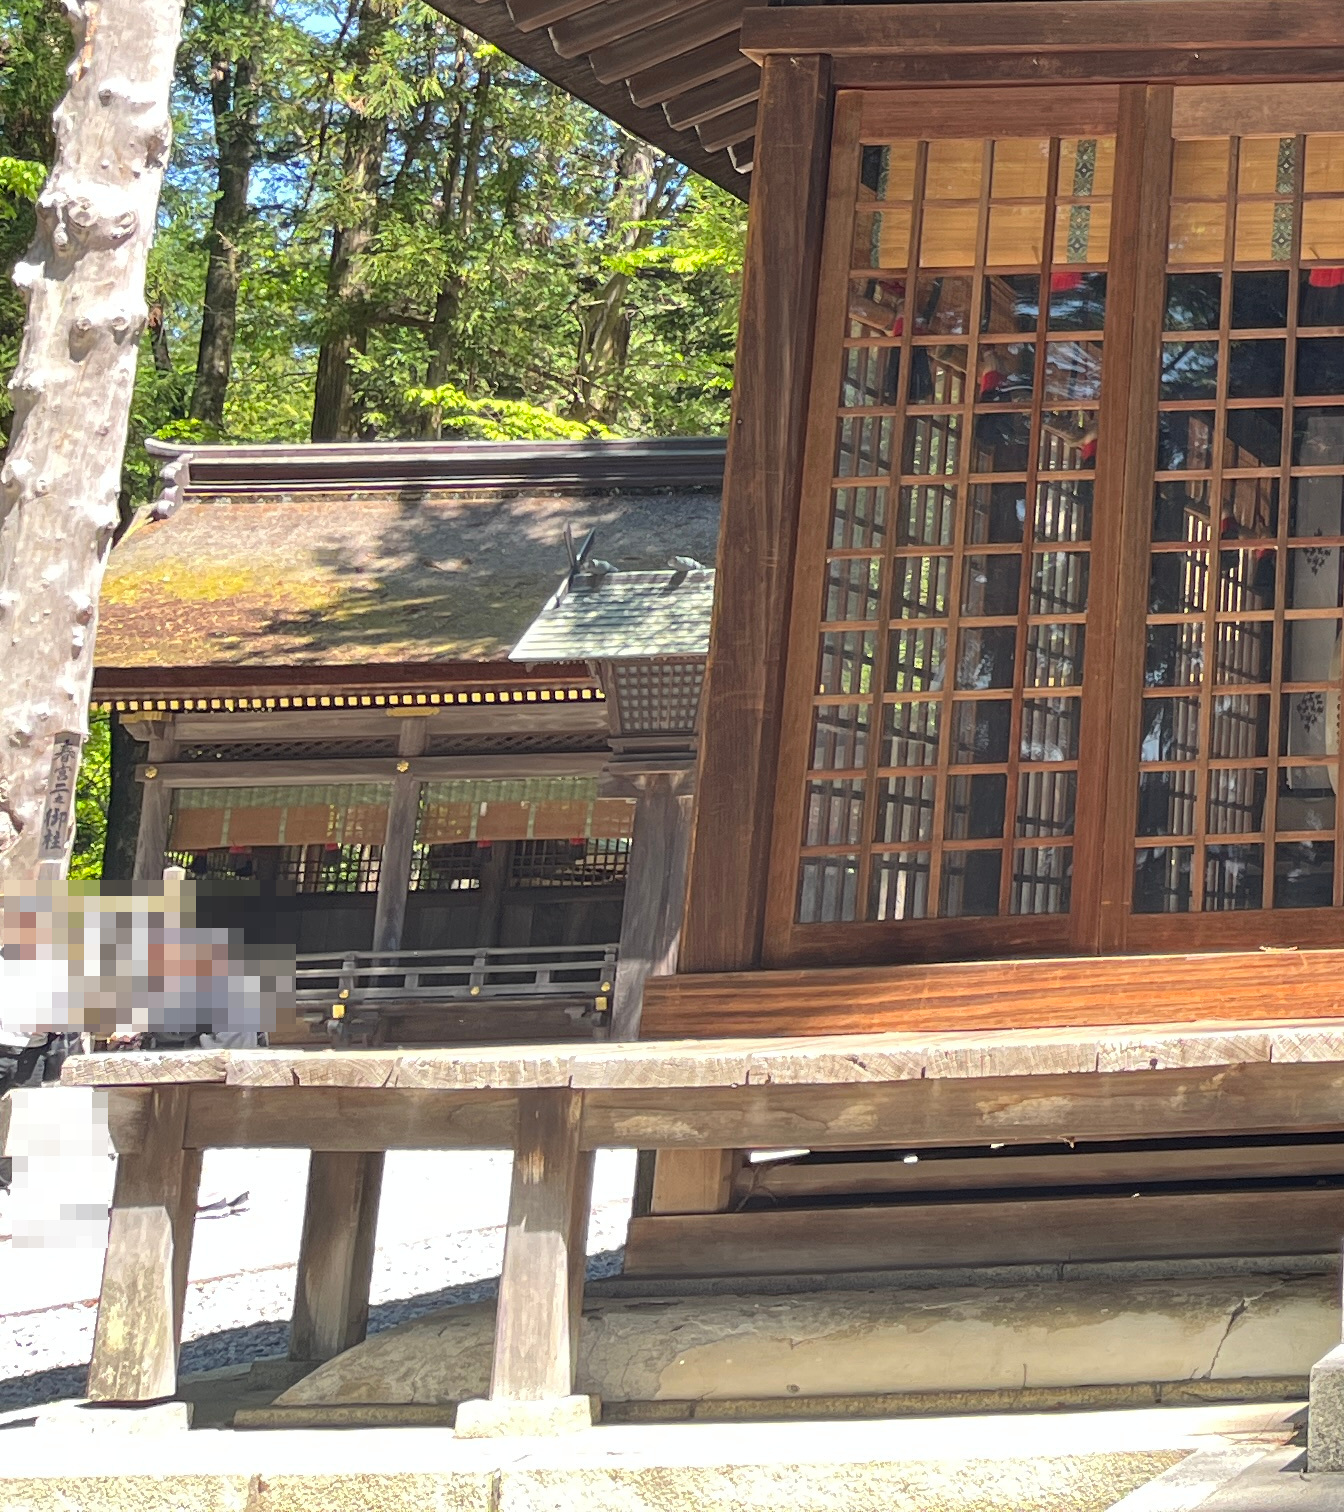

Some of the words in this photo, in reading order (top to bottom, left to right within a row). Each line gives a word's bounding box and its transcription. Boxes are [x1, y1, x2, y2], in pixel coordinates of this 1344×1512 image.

[42, 739, 76, 850] 春宮二之御柱
